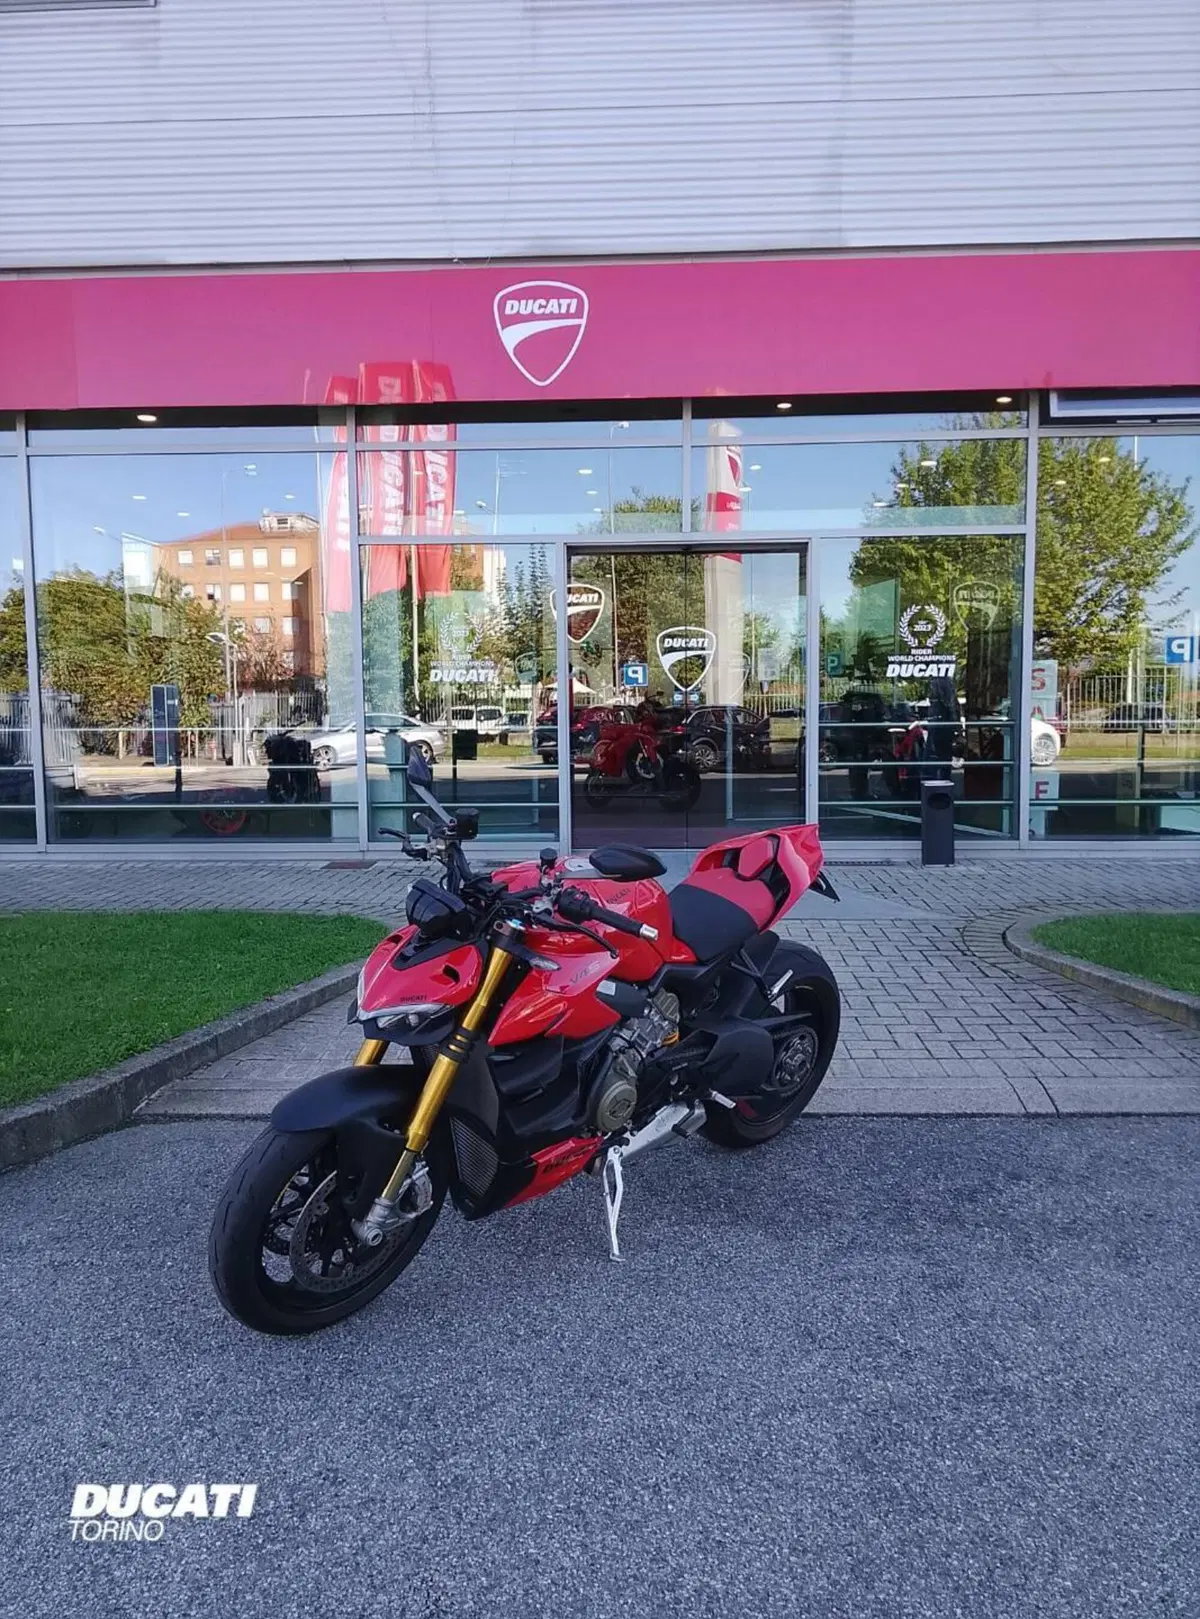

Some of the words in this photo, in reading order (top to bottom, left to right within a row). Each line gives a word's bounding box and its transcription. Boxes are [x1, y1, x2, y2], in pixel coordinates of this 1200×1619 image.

[505, 298, 578, 315] DUCATI
[566, 593, 599, 603] UCATI
[663, 637, 709, 648] DUCATI
[429, 669, 496, 682] DUCATI
[886, 664, 956, 678] DUCATI
